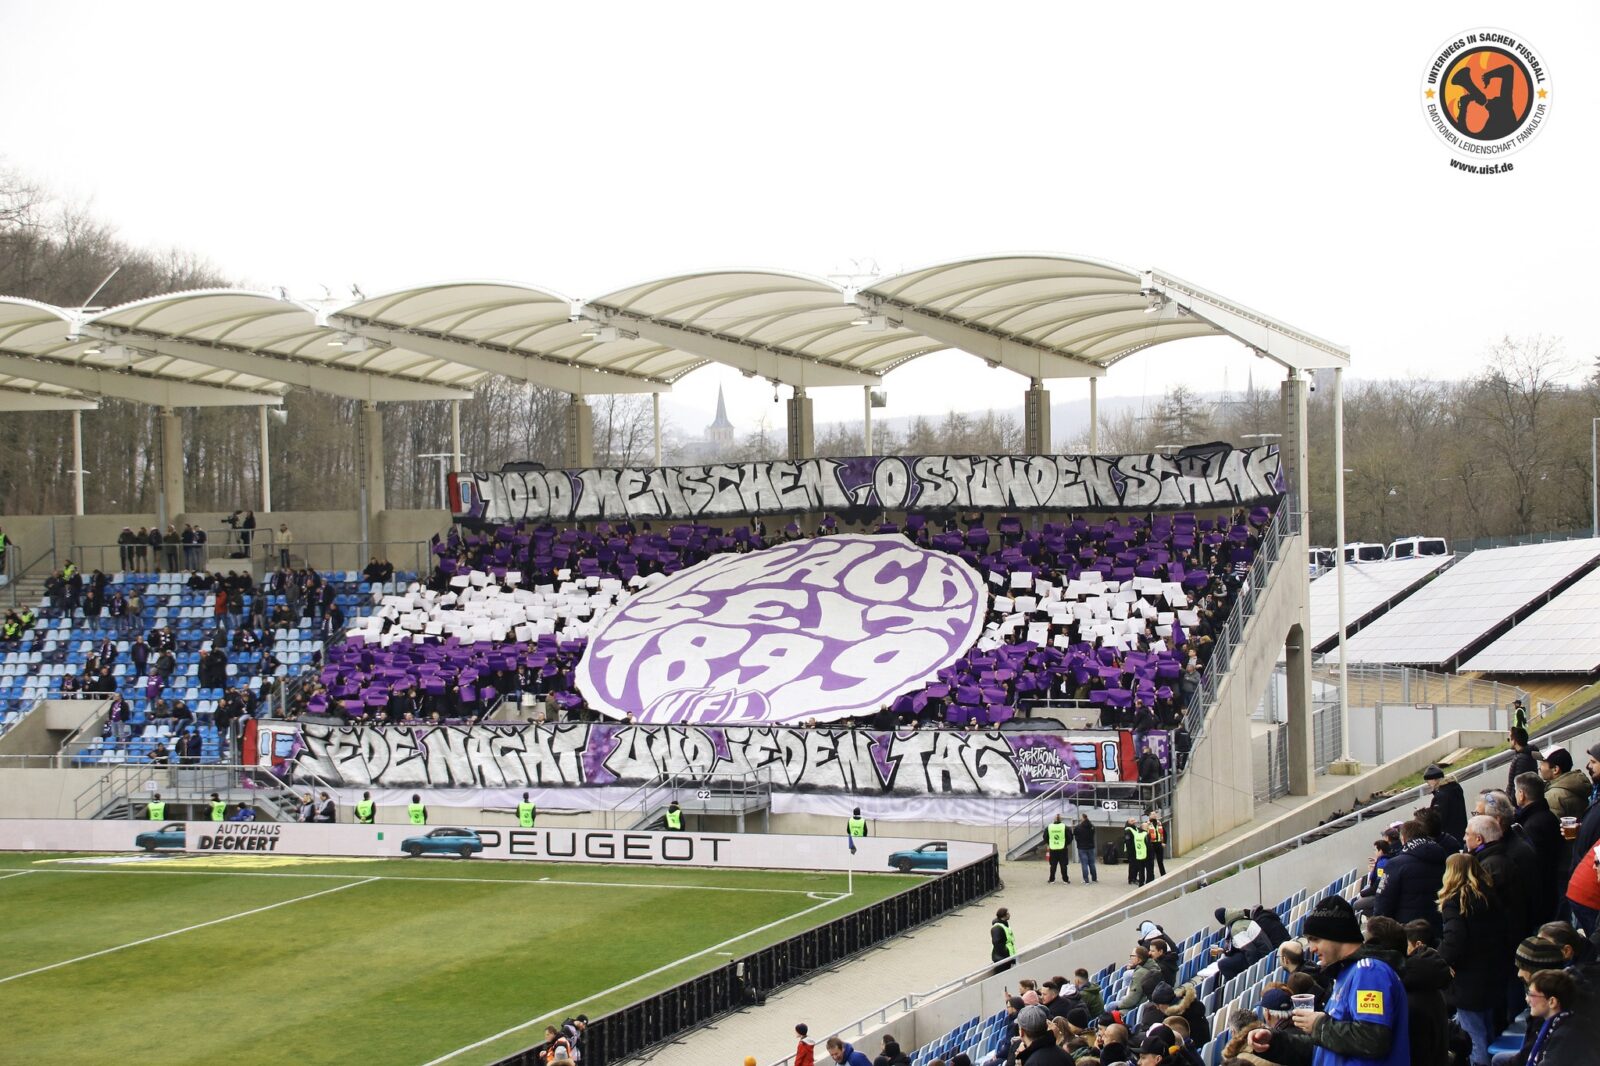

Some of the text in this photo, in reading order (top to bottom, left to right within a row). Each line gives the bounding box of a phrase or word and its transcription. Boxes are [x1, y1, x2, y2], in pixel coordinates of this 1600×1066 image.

[478, 470, 574, 522] 1000
[909, 455, 1122, 509] STUNDEN
[596, 622, 950, 723] 1899
[294, 724, 1022, 793] JEDE NACHT UND JEDEN TAG
[697, 790, 710, 799] C2
[1103, 801, 1117, 810] C3
[217, 824, 281, 836] AUTOHAUS
[200, 836, 279, 850] DECKERT
